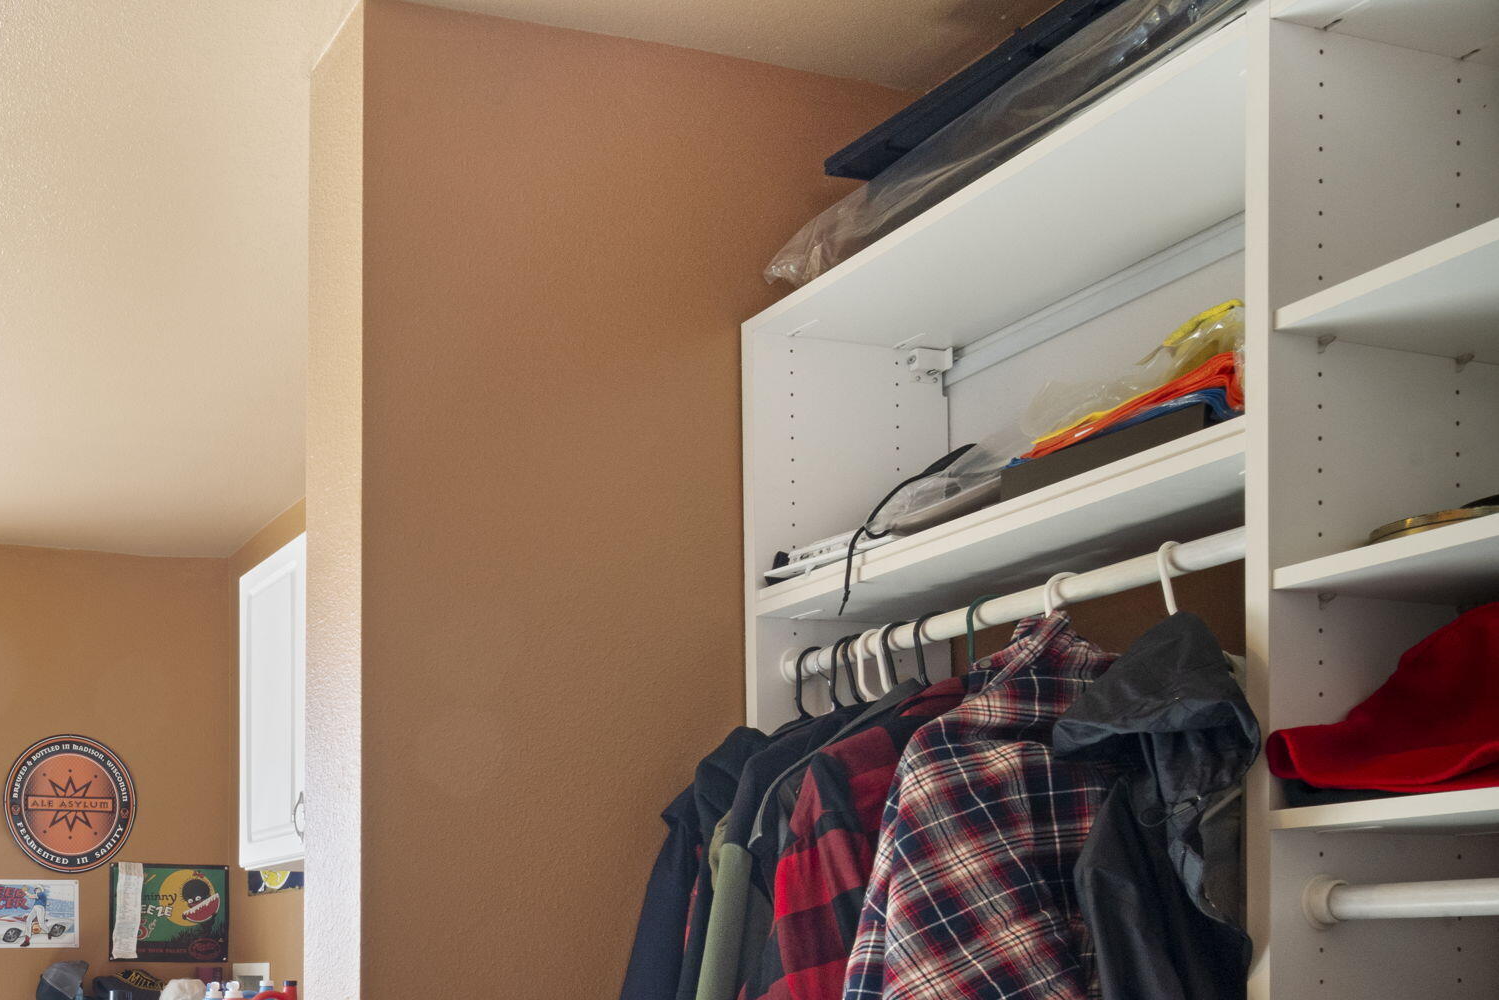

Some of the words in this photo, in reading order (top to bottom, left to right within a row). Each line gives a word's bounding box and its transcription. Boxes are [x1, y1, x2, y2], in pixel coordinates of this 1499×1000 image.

[13, 766, 28, 799] BREWED
[31, 745, 60, 762] BOTTLED
[72, 744, 105, 762] MADISON,
[106, 760, 128, 802] WISCONSIN
[60, 801, 109, 809] ASYLUM
[17, 822, 69, 865] FERMENTED
[94, 825, 124, 858] SANITY
